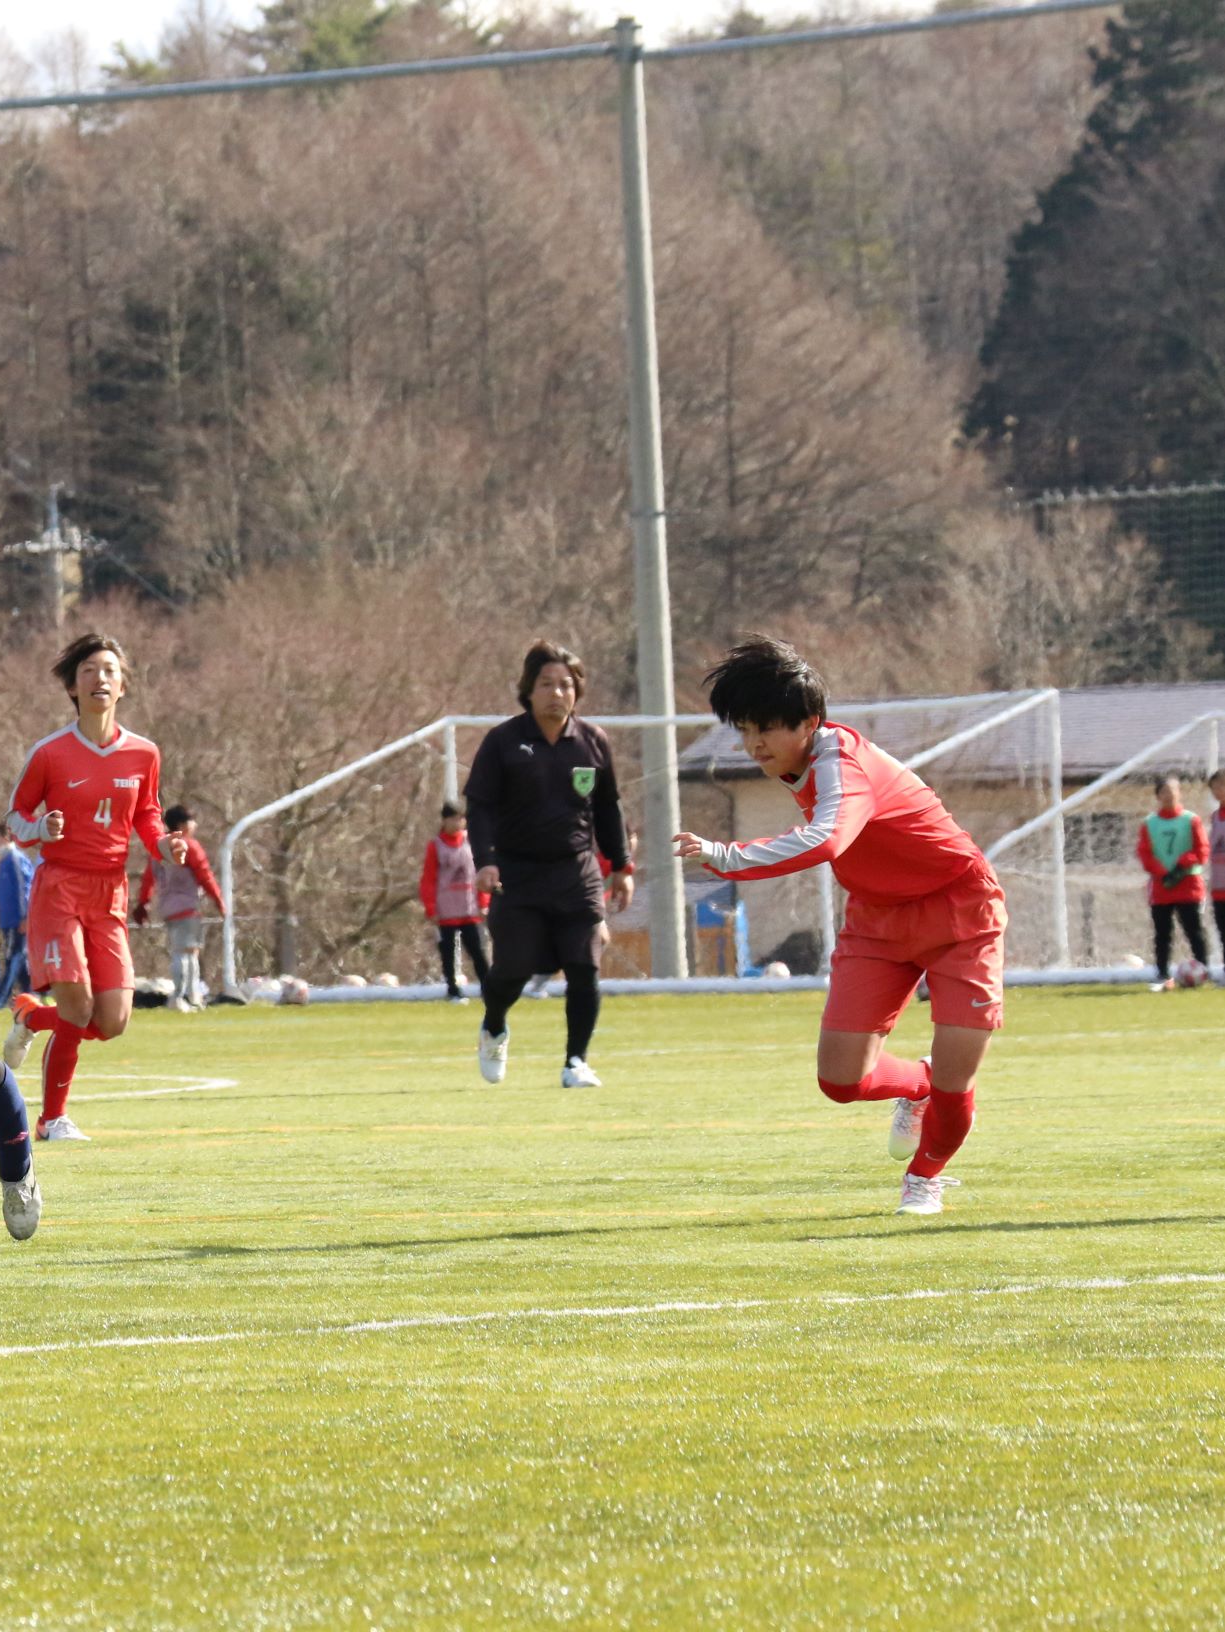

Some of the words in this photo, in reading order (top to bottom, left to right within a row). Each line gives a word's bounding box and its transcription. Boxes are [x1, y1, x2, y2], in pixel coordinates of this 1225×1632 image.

[93, 797, 112, 830] 4
[1161, 830, 1177, 856] 7
[43, 938, 63, 970] 4
